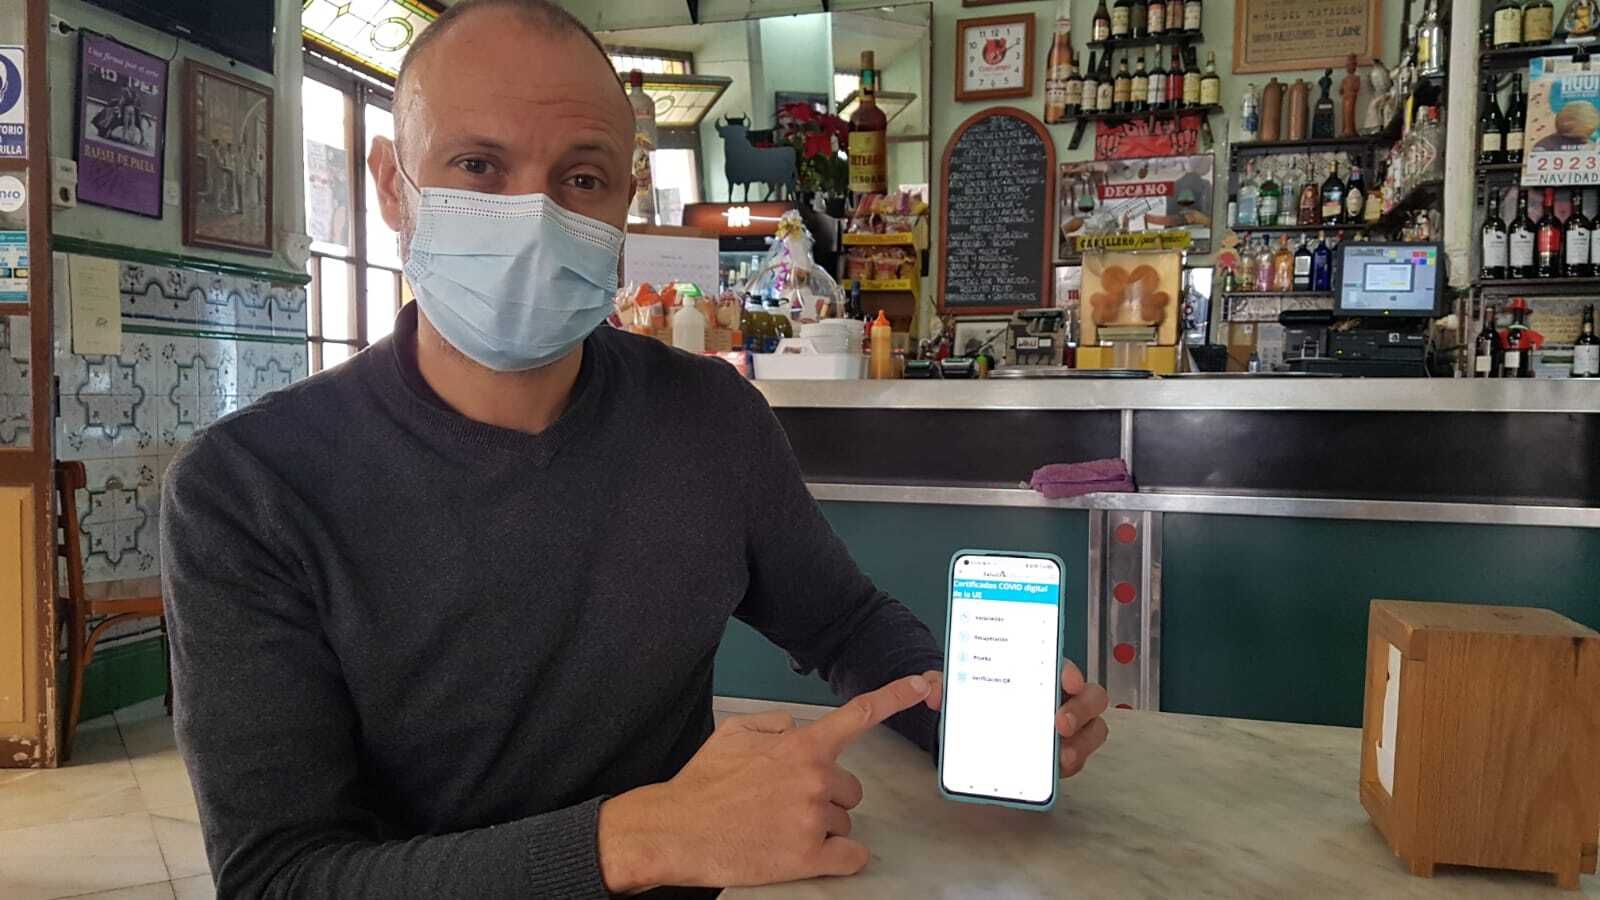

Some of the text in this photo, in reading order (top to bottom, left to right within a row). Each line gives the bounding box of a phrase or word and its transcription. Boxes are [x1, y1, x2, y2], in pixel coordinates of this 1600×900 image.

[0, 124, 24, 136] ORIO
[1540, 172, 1599, 185] NAVIDAD
[1105, 183, 1168, 198] DECANO
[953, 580, 1049, 594] Certificados COVID digital
[971, 591, 982, 599] UE
